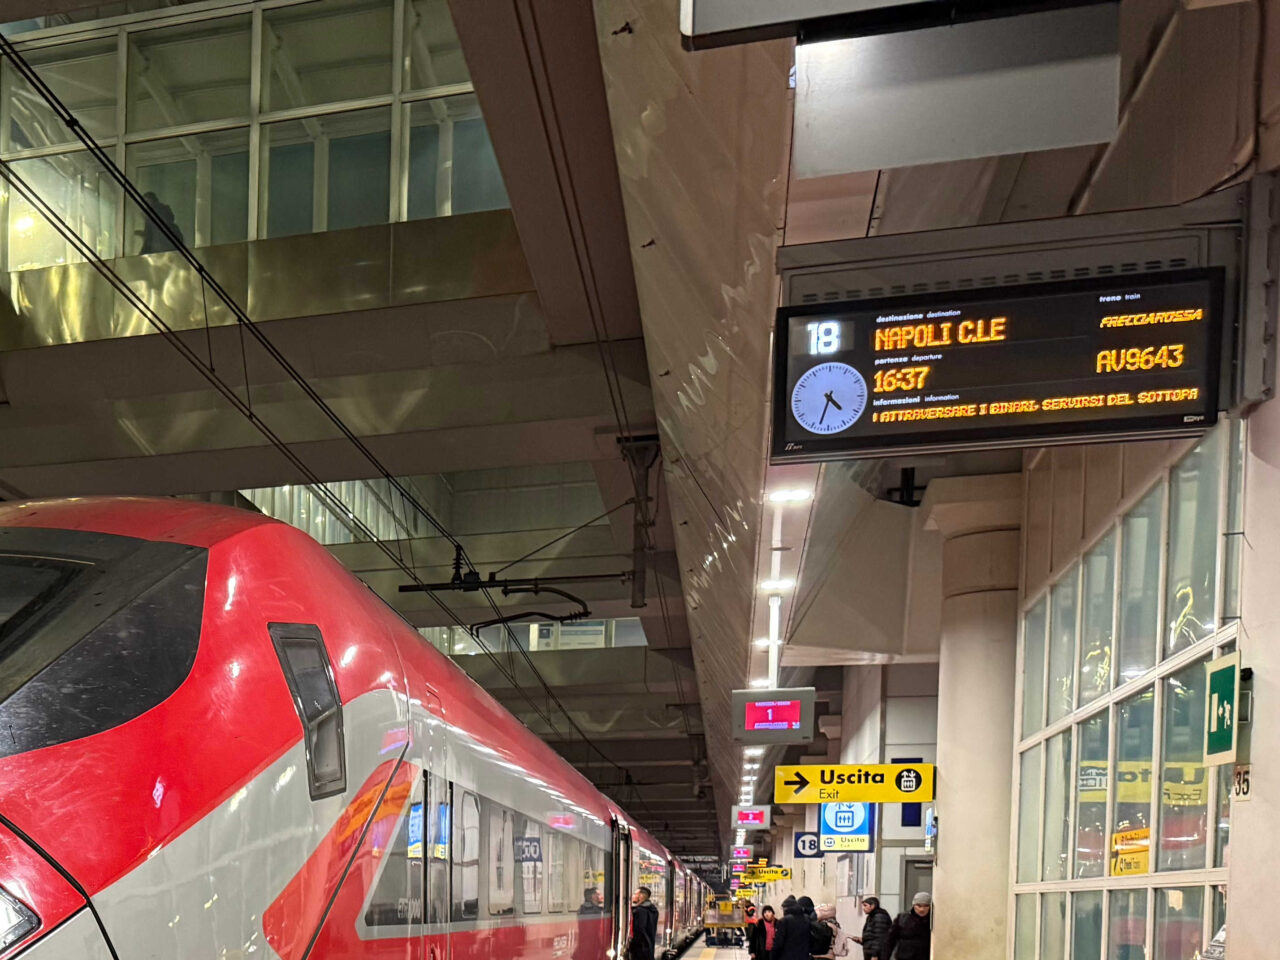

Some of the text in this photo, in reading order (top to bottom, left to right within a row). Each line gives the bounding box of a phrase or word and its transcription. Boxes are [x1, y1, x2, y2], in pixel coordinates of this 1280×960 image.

[876, 309, 961, 323] destinazione destination
[1100, 309, 1203, 328] FRECCIAROSSA
[807, 319, 842, 355] 18
[874, 317, 1007, 351] NAPOLI C.LE
[911, 352, 943, 362] departure
[1095, 344, 1185, 374] AV9643
[872, 365, 931, 393] 16:37
[873, 393, 960, 406] informazioni information
[880, 405, 976, 423] ATTRAVERSARE
[1041, 395, 1106, 411] SERVIRSI
[1106, 393, 1135, 406] DEL
[1137, 387, 1199, 405] SOTTOPA
[819, 768, 885, 785] Uscita
[1235, 770, 1251, 797] 35
[819, 788, 840, 800] Exit
[800, 838, 818, 851] 18
